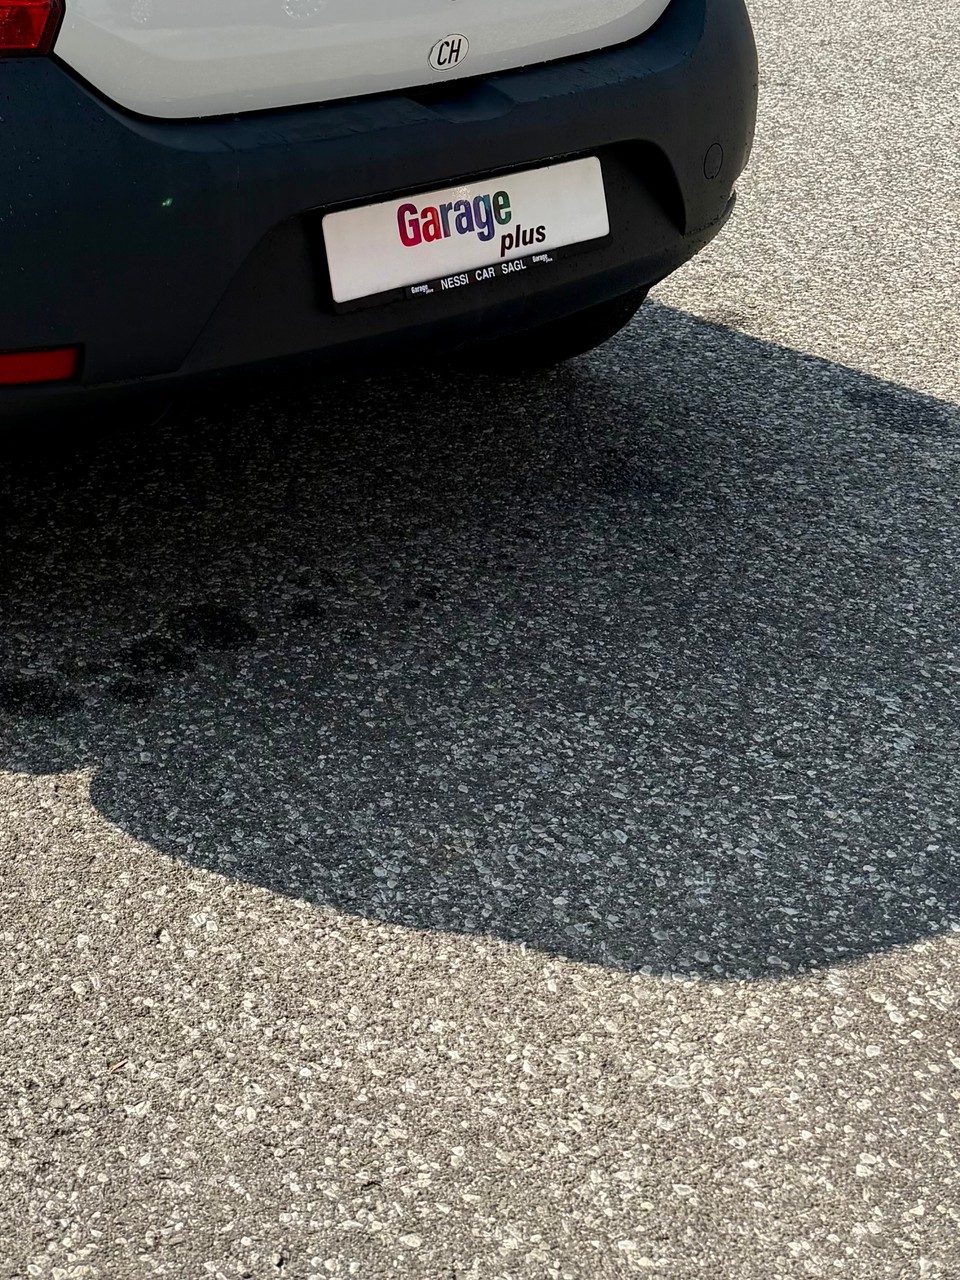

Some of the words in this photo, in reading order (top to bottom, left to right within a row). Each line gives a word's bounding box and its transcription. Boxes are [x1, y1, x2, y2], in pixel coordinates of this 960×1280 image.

[436, 38, 461, 67] CH
[396, 190, 512, 247] Garage
[500, 223, 547, 257] plus
[440, 273, 469, 291] NESSI
[475, 267, 496, 281] CAR
[501, 259, 527, 275] SAGL
